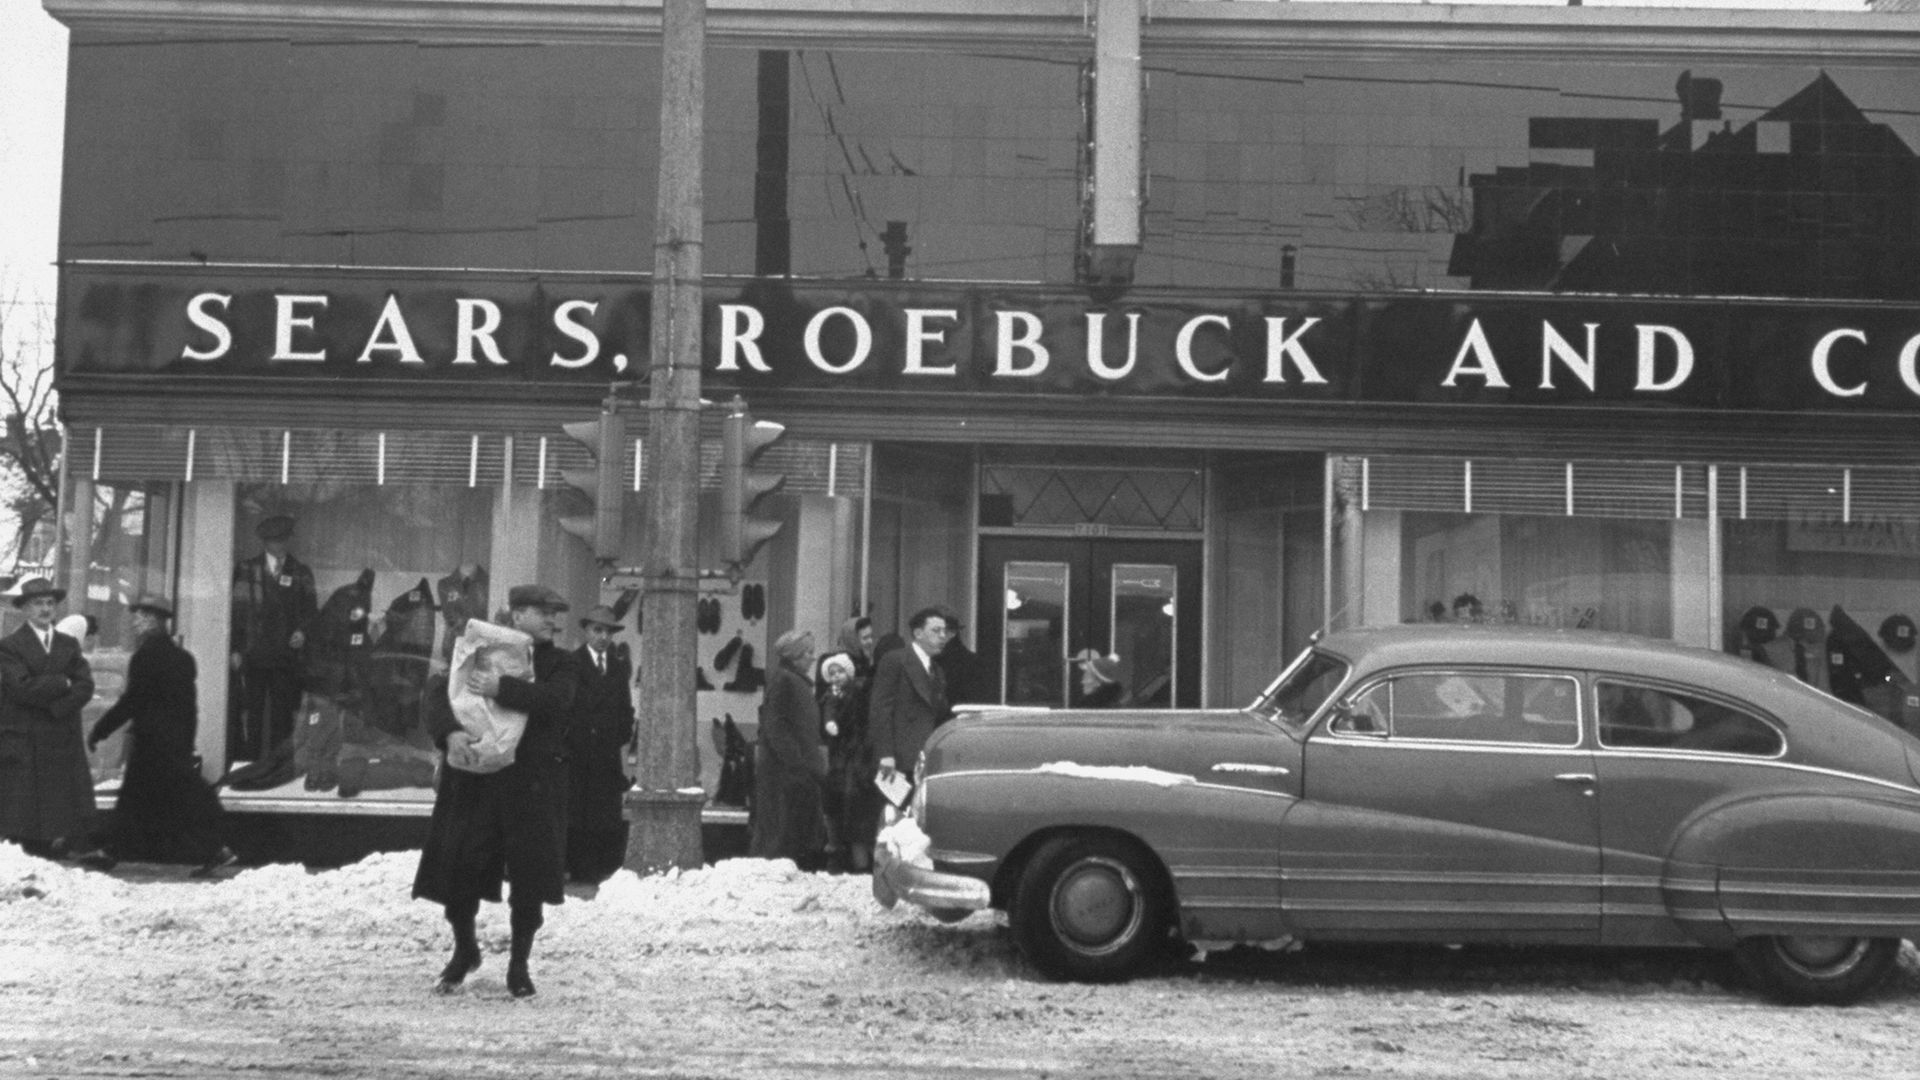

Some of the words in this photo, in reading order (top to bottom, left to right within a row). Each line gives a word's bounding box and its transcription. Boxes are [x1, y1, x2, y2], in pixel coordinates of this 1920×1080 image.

[182, 292, 628, 373] SEARS,
[716, 304, 1329, 384] ROEBUCK
[1441, 318, 1695, 392] AND
